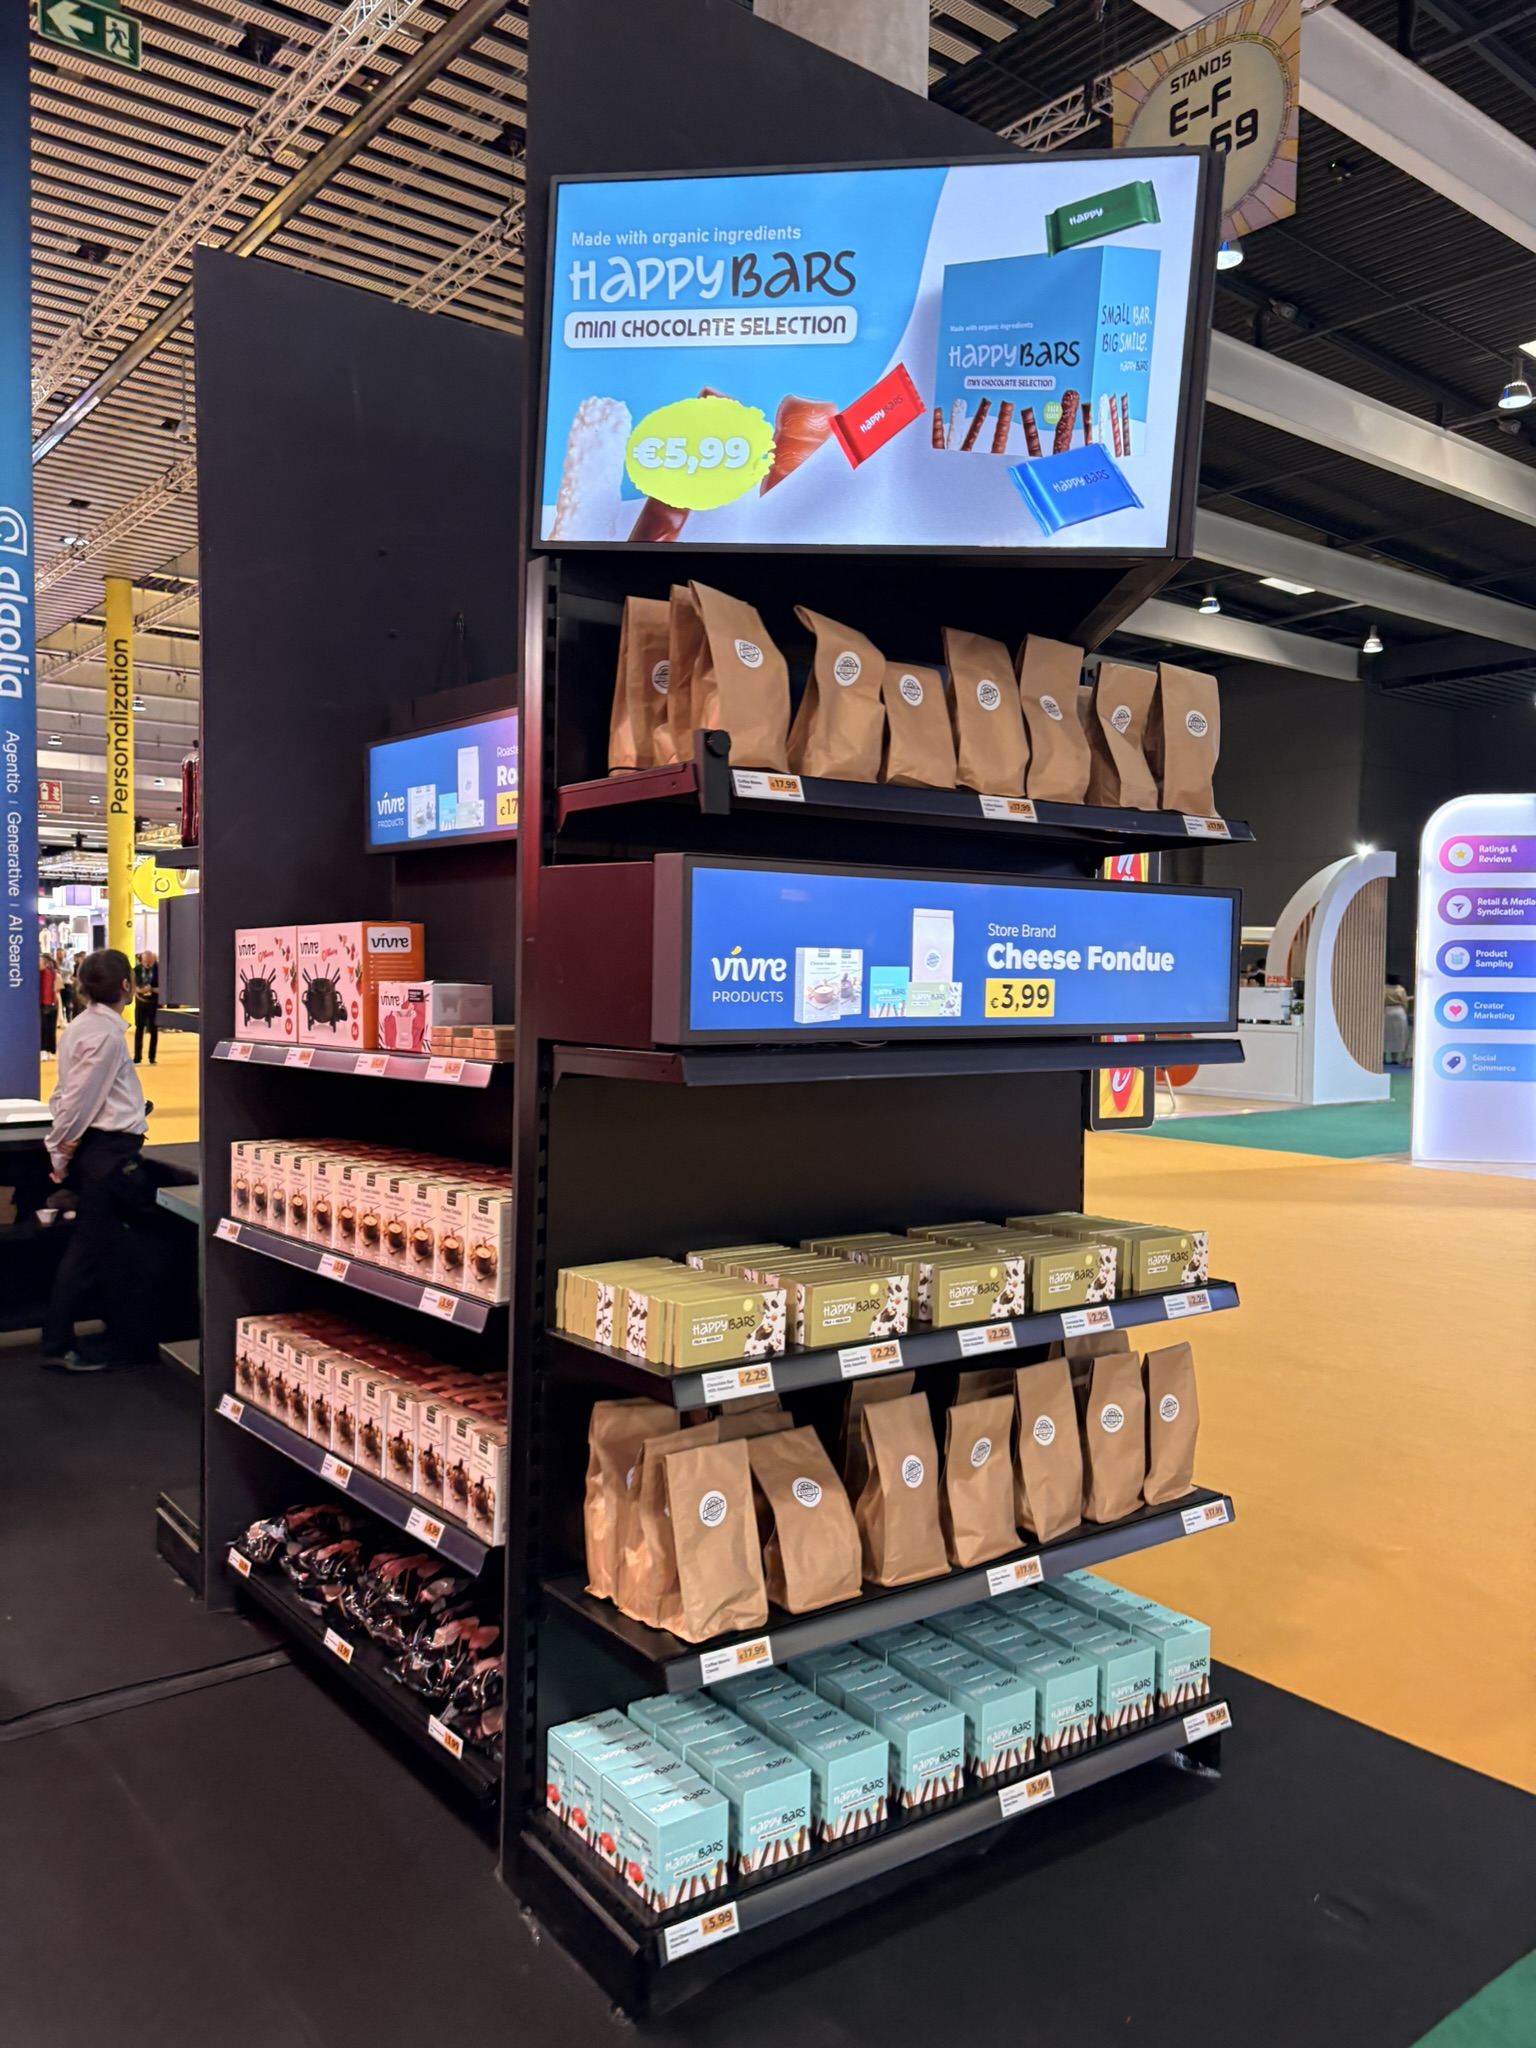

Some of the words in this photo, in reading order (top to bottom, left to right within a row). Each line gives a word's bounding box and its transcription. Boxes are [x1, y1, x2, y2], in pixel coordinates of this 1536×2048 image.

[1170, 50, 1231, 95] STANDS
[572, 231, 611, 247] Made
[616, 230, 647, 245] with
[652, 228, 710, 247] organic
[714, 225, 802, 245] ingredients
[1132, 305, 1152, 326] BAR.
[575, 320, 616, 338] MINI
[622, 317, 735, 338] CHOCOLATE
[740, 315, 846, 336] SELECTION
[1102, 333, 1118, 352] BIG
[967, 378, 981, 387] MINI
[981, 378, 1017, 387] CHOCOLATE
[1018, 378, 1053, 387] SELECTION
[633, 437, 750, 474] €5,99
[109, 638, 130, 814] Personalization
[4, 730, 21, 793] Agentic
[377, 818, 404, 828] PRODUCTS
[7, 812, 23, 897] Generative
[1479, 845, 1510, 855] Ratings
[1511, 845, 1517, 853] &
[1479, 855, 1512, 863] Reviews
[1477, 897, 1500, 906] Retail
[1502, 897, 1508, 905] &
[1510, 898, 1536, 906] Media
[1477, 907, 1524, 917] Syndication
[8, 914, 23, 931] AI
[988, 923, 1018, 937] Store
[1022, 924, 1056, 938] Brand
[9, 934, 23, 988] Search
[986, 942, 1081, 970] Cheese
[1087, 945, 1174, 972] Fondue
[1475, 950, 1508, 958] Product
[1475, 960, 1513, 969] Sampling
[712, 991, 784, 1002] PRODUCTS
[990, 984, 1049, 1011] €3,99
[1474, 1002, 1504, 1010] Creator
[1473, 1012, 1515, 1021] Marketing
[1472, 1054, 1496, 1062] Social
[1472, 1064, 1516, 1072] Commerce
